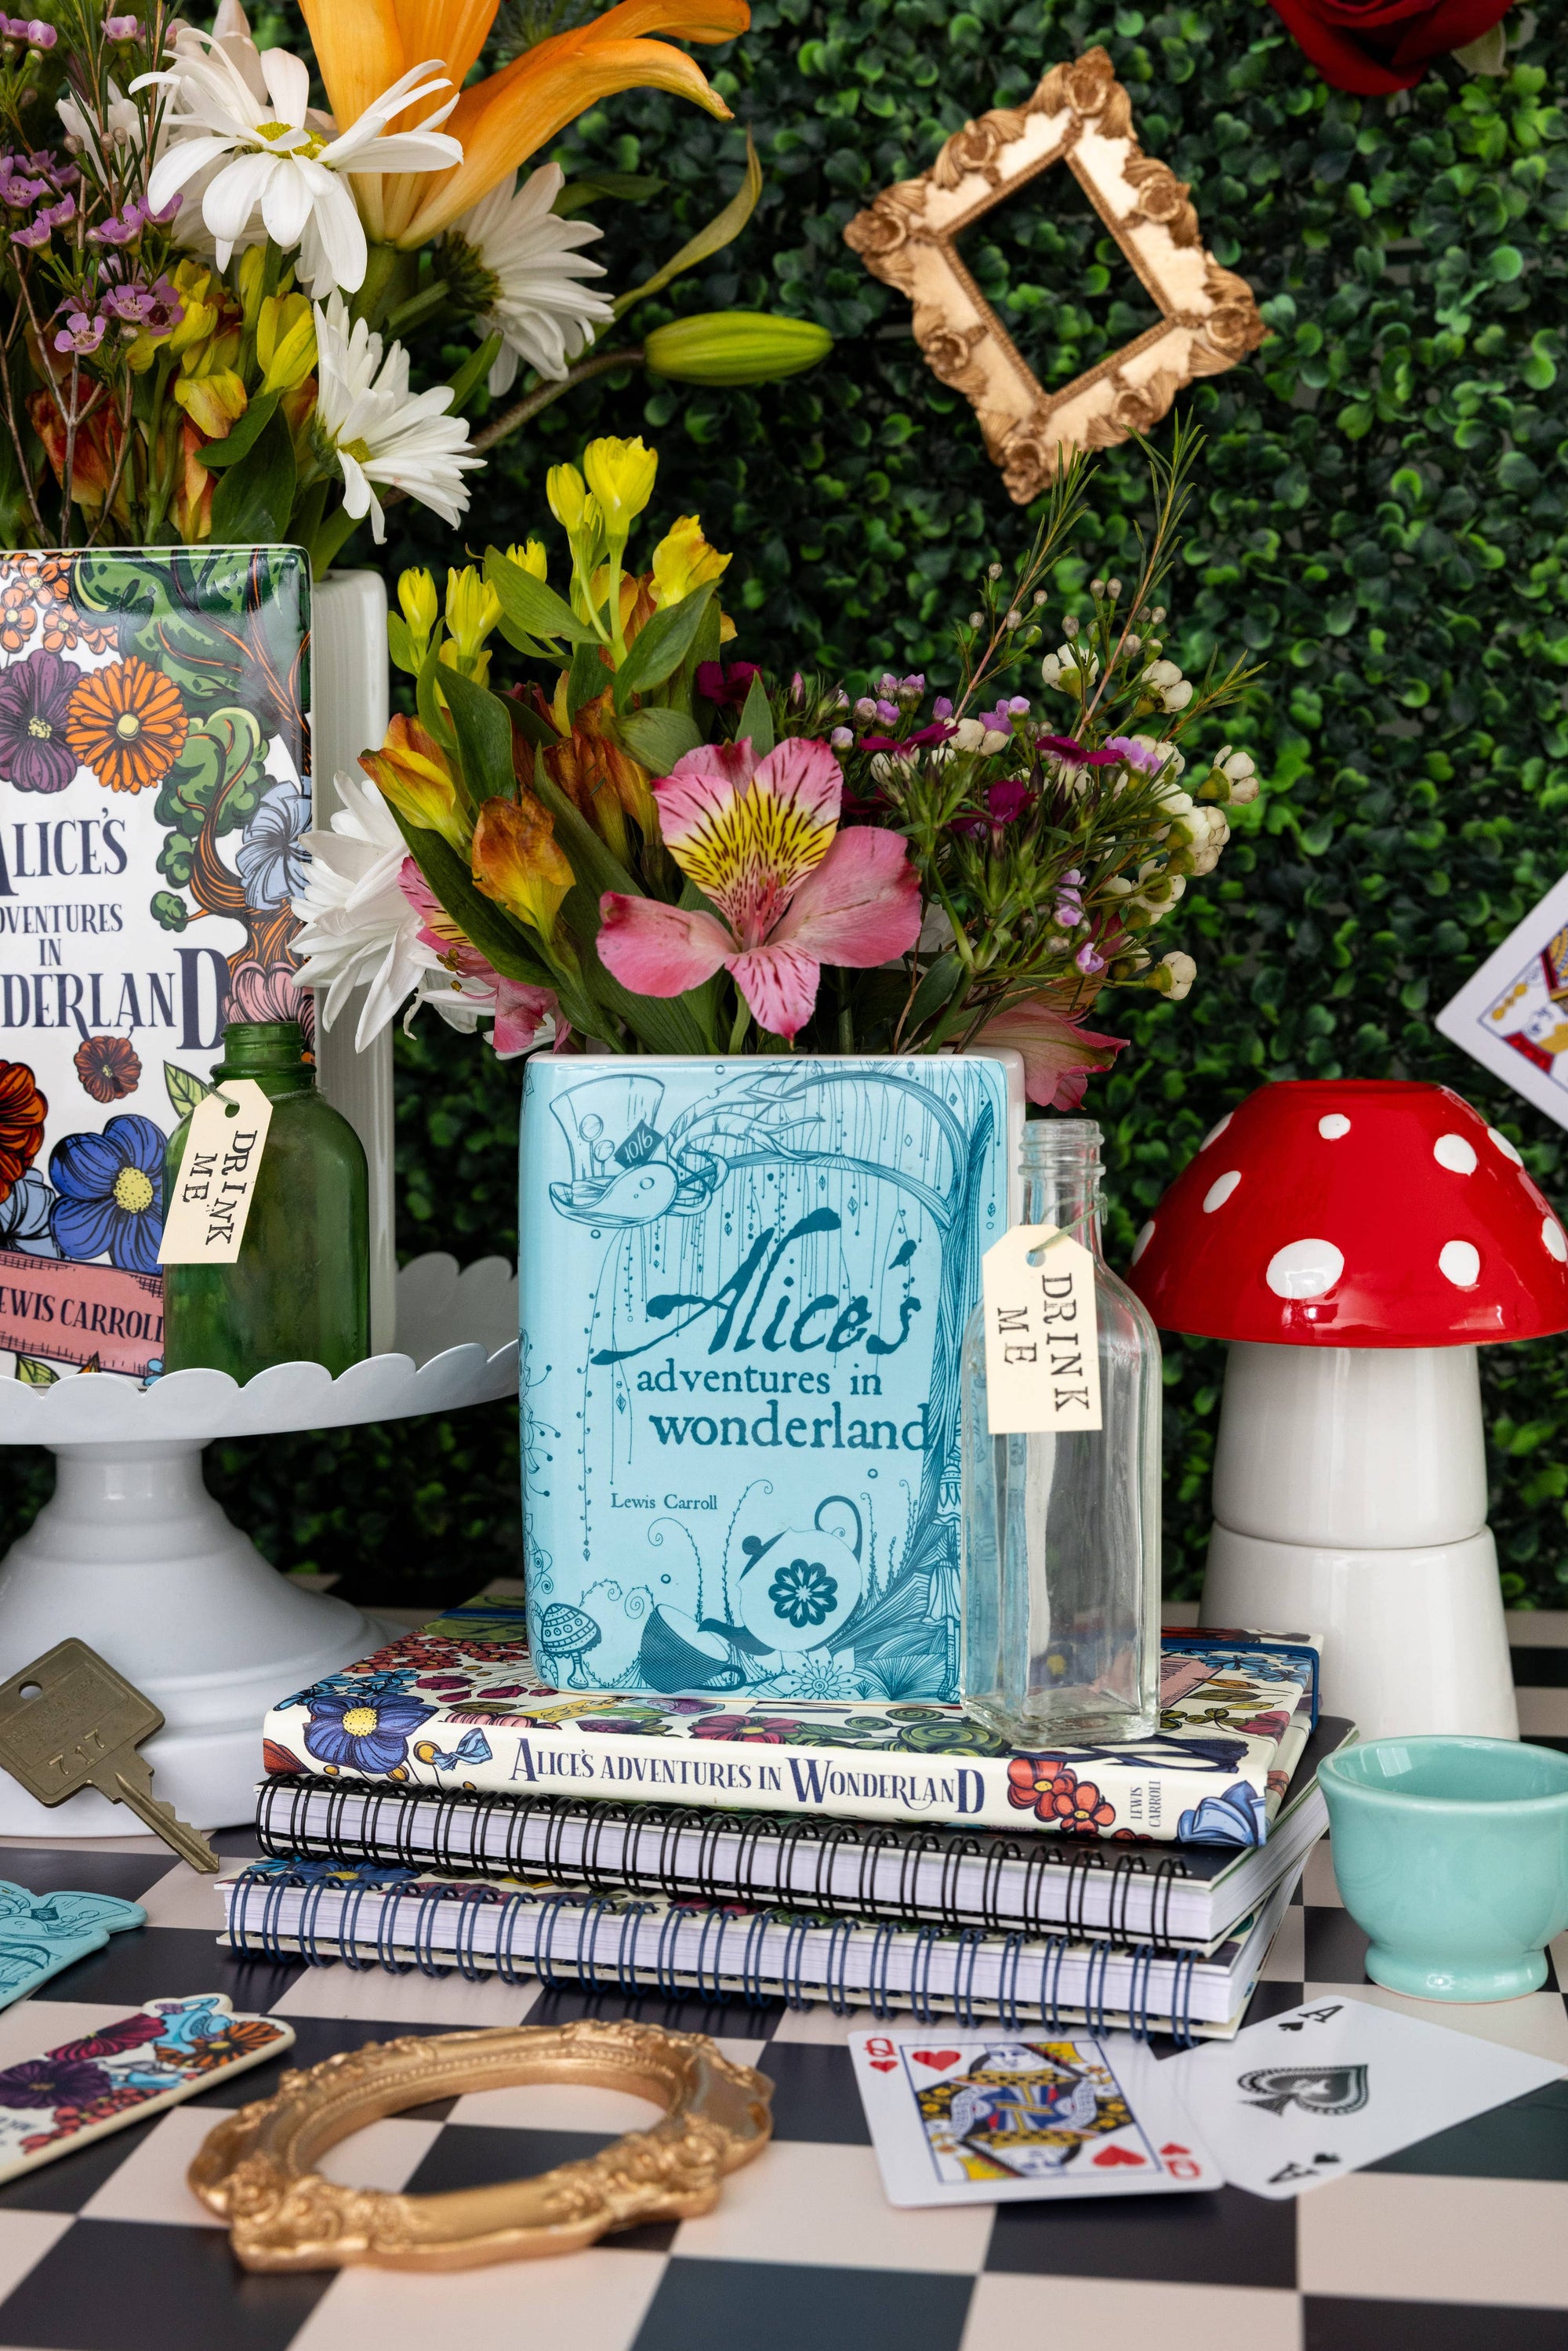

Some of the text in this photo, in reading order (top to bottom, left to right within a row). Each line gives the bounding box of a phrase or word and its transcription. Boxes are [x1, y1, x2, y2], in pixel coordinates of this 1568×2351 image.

[38, 938, 62, 966] IN
[624, 1129, 653, 1164] 10/6
[182, 1153, 218, 1203] ME
[205, 1130, 258, 1245] DRINK
[590, 1207, 921, 1365] Alice's
[997, 1306, 1037, 1364] ME
[1042, 1273, 1090, 1412] DRINK
[637, 1358, 883, 1395] adventures in
[648, 1399, 933, 1450] wonderland
[611, 1492, 718, 1510] Lewis Carroll
[49, 1728, 105, 1775] 717
[508, 1738, 985, 1814] ALICE'S ADVENTURES IN WONDERLAND
[1131, 1786, 1142, 1819] LEWIS
[1149, 1780, 1161, 1827] CARROLL
[1298, 2004, 1345, 2023] A
[863, 2037, 898, 2058] Q
